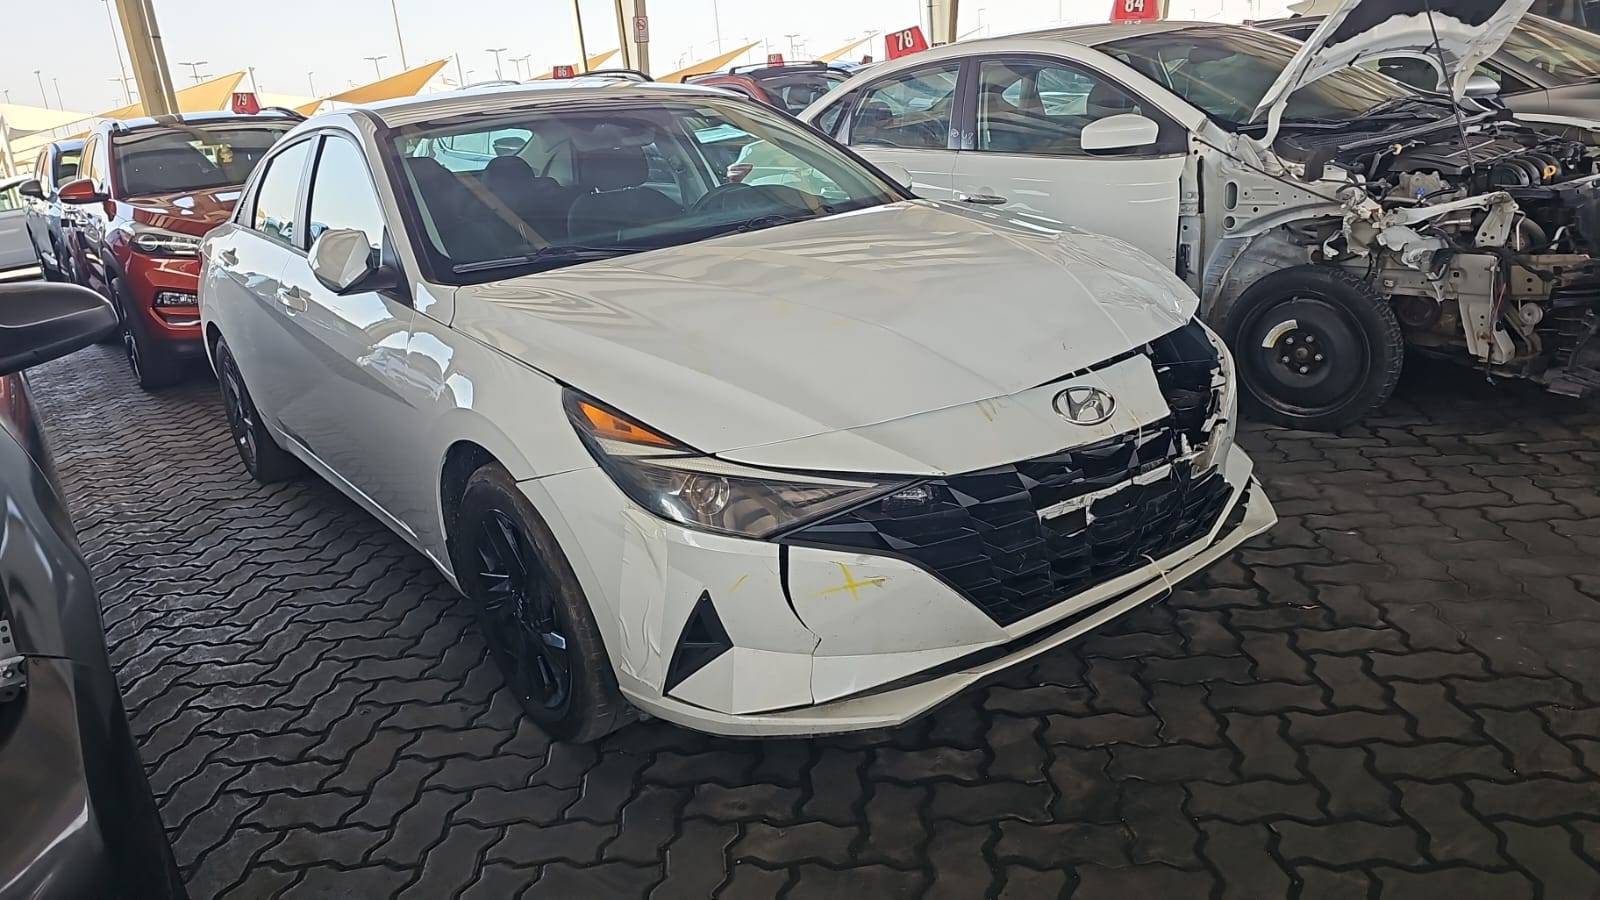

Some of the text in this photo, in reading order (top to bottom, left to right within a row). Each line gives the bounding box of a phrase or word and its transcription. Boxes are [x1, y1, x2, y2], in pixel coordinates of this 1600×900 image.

[1125, 0, 1143, 12] 84
[895, 30, 914, 50] 78
[237, 94, 247, 106] 79
